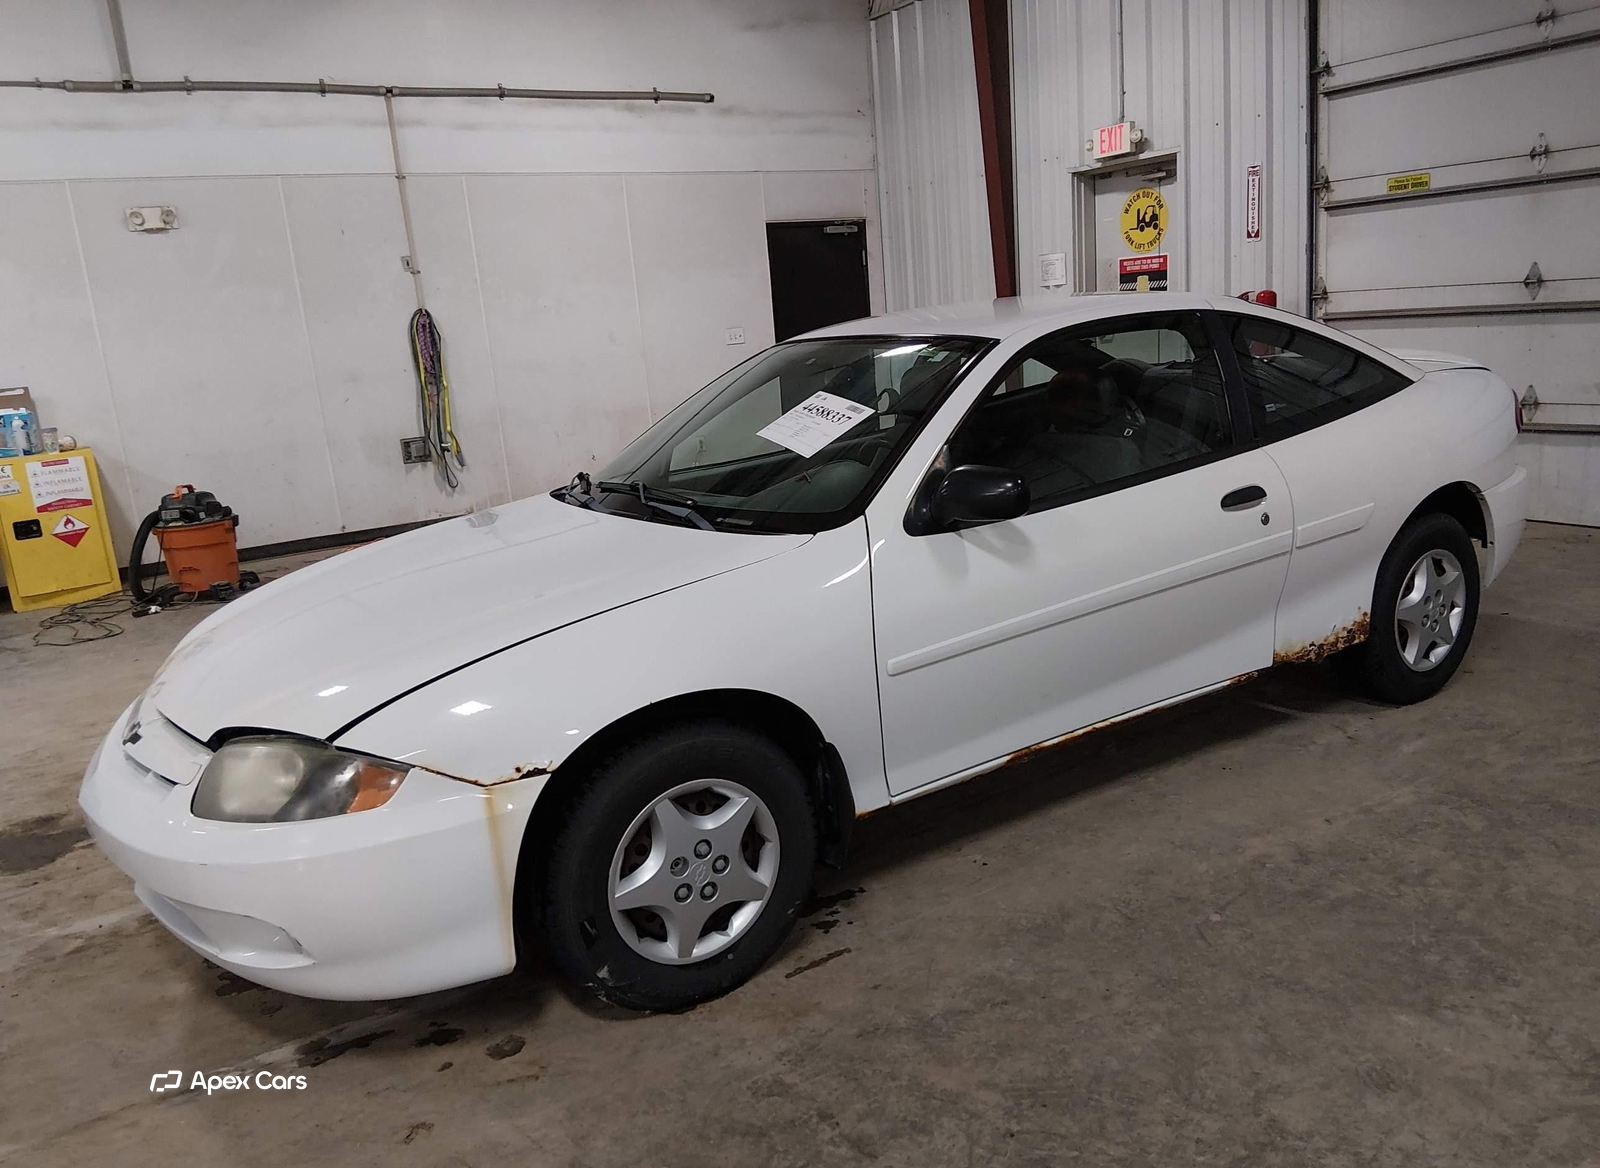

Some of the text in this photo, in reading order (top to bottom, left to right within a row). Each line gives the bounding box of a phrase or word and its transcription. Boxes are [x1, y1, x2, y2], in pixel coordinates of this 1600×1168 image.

[1100, 125, 1124, 154] EXIT
[1389, 181, 1428, 192] STUDENT DRIVER
[1124, 191, 1164, 215] WATCH OUT FOR
[1123, 231, 1135, 247] FORK
[1146, 226, 1164, 249] TRUCKS
[802, 402, 852, 425] 44588337
[41, 466, 80, 476] FLAMMABLE
